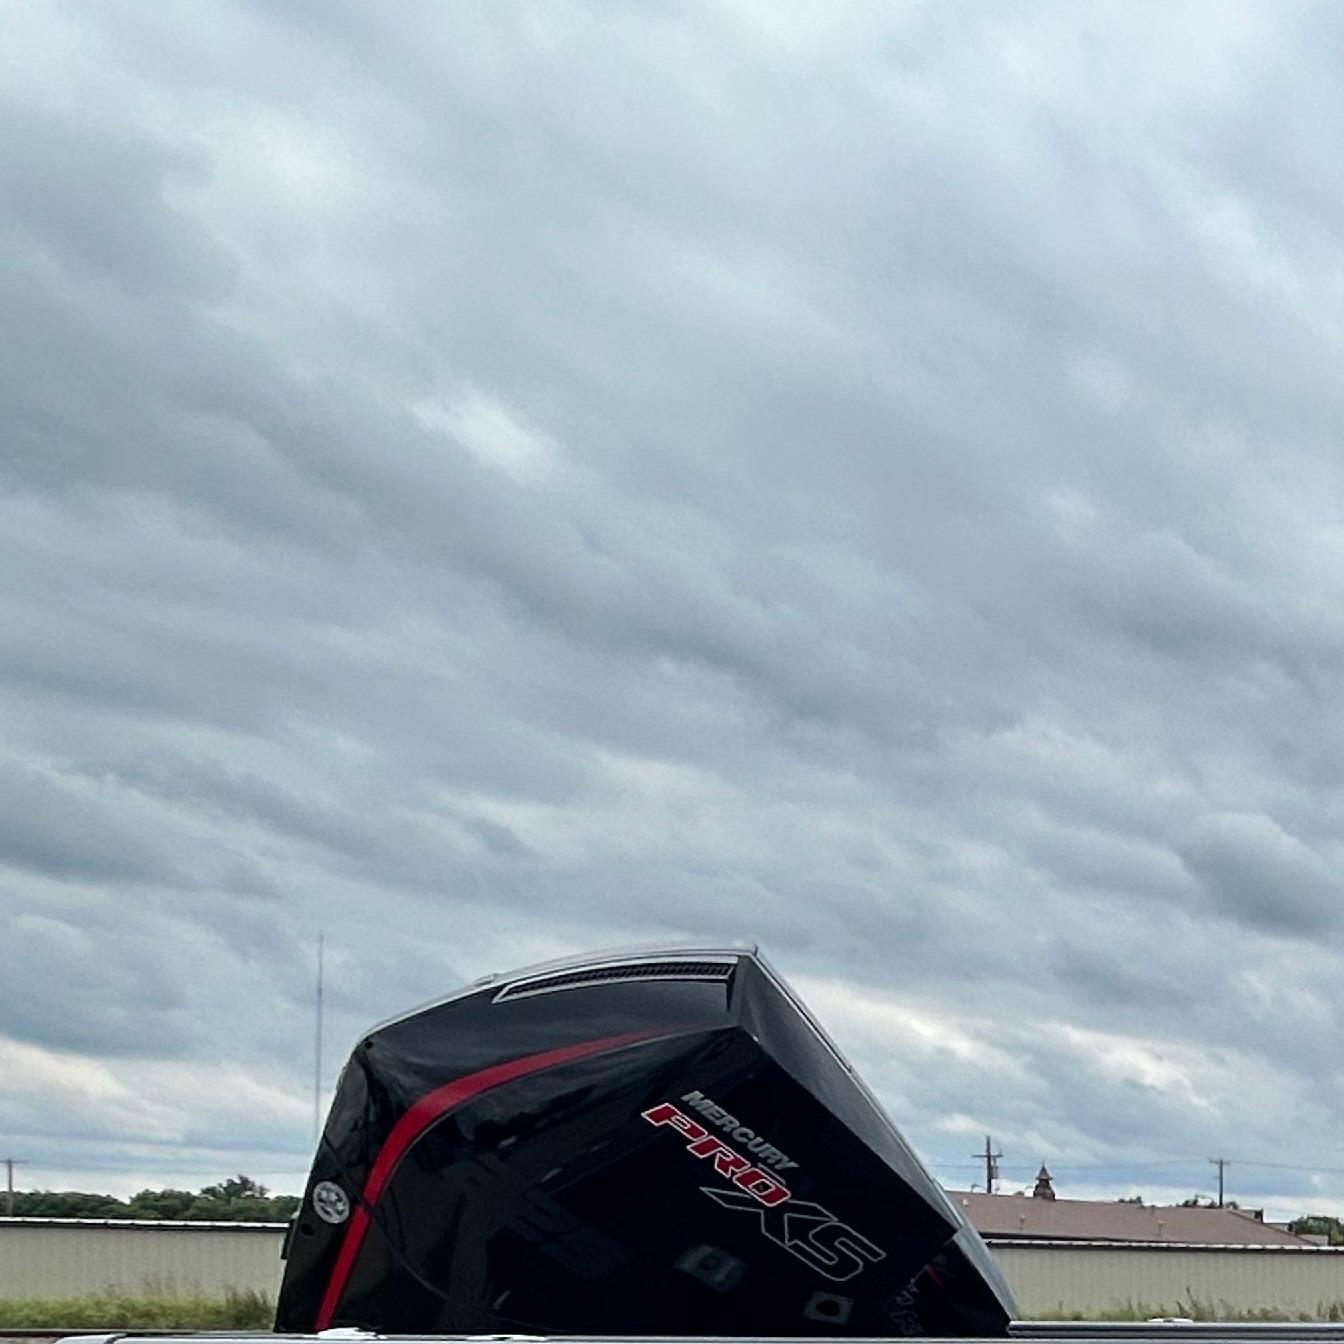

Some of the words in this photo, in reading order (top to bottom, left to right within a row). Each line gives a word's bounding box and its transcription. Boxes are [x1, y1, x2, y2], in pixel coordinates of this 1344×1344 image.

[641, 1102, 792, 1208] PRO
[681, 1090, 800, 1171] MERCURY
[699, 1186, 887, 1282] XS
